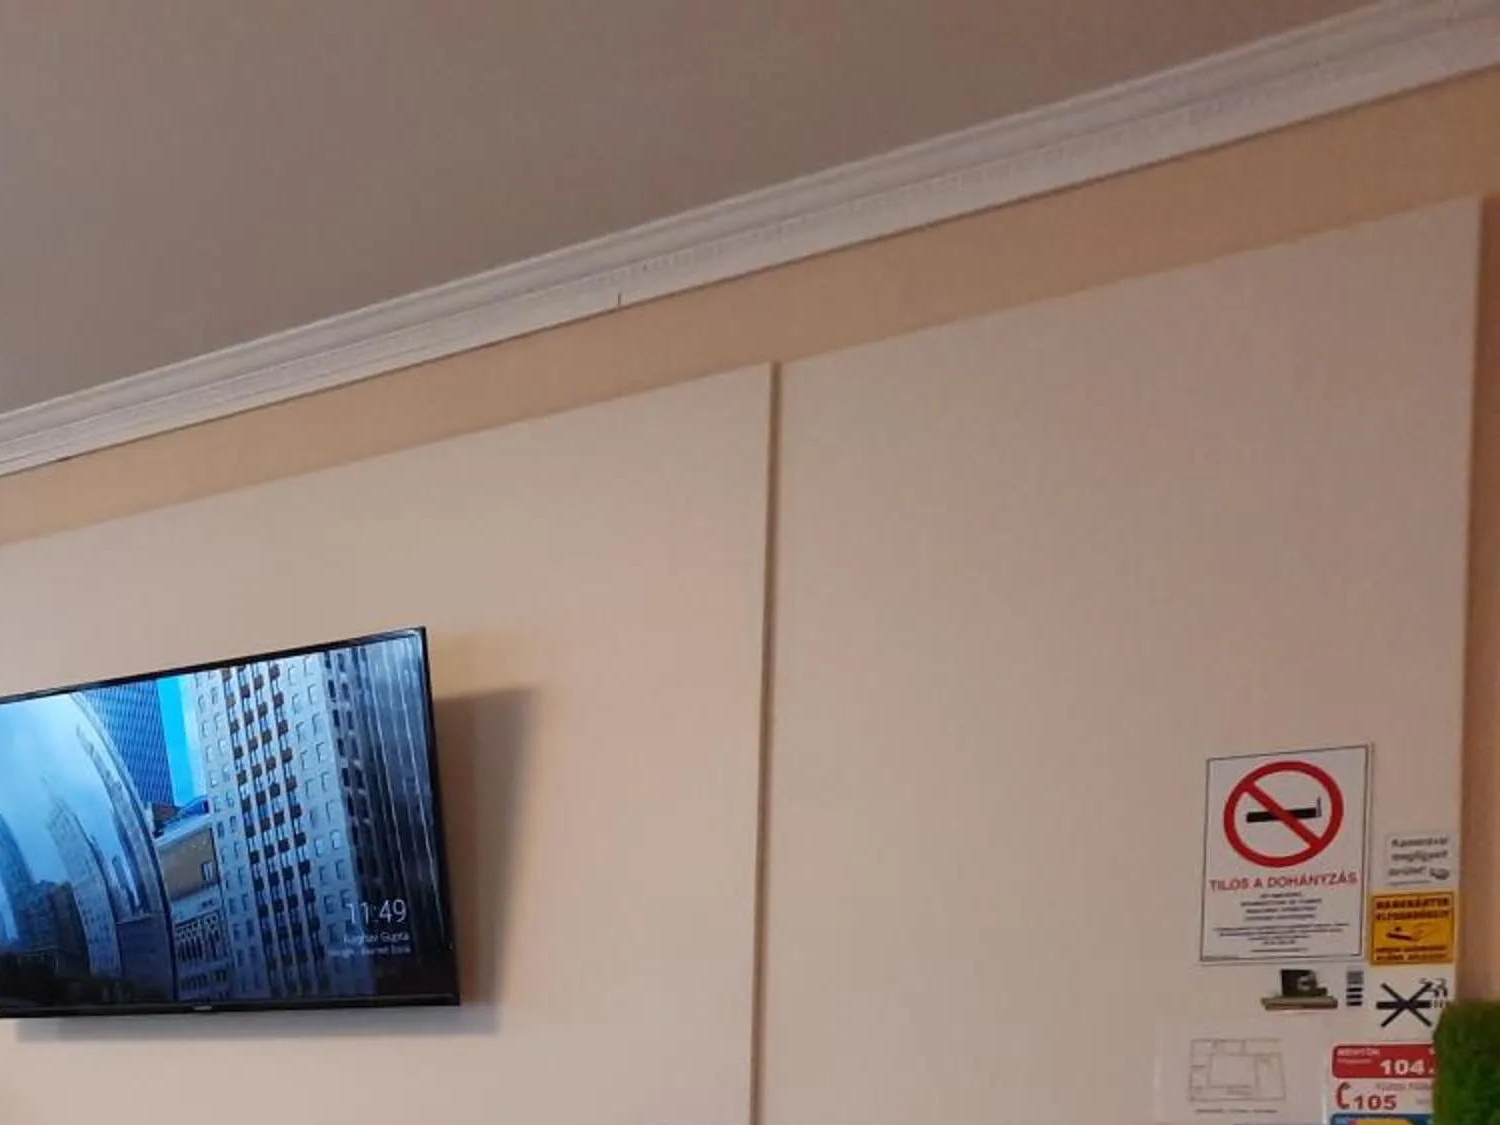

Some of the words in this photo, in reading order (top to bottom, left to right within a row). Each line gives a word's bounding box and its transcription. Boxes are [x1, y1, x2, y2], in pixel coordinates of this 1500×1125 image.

[1209, 879, 1249, 892] TILOS
[1253, 877, 1265, 889] A
[1267, 871, 1358, 889] DOHÁNYZÁS
[1380, 1059, 1425, 1076] 104
[1353, 1094, 1397, 1111] 105
